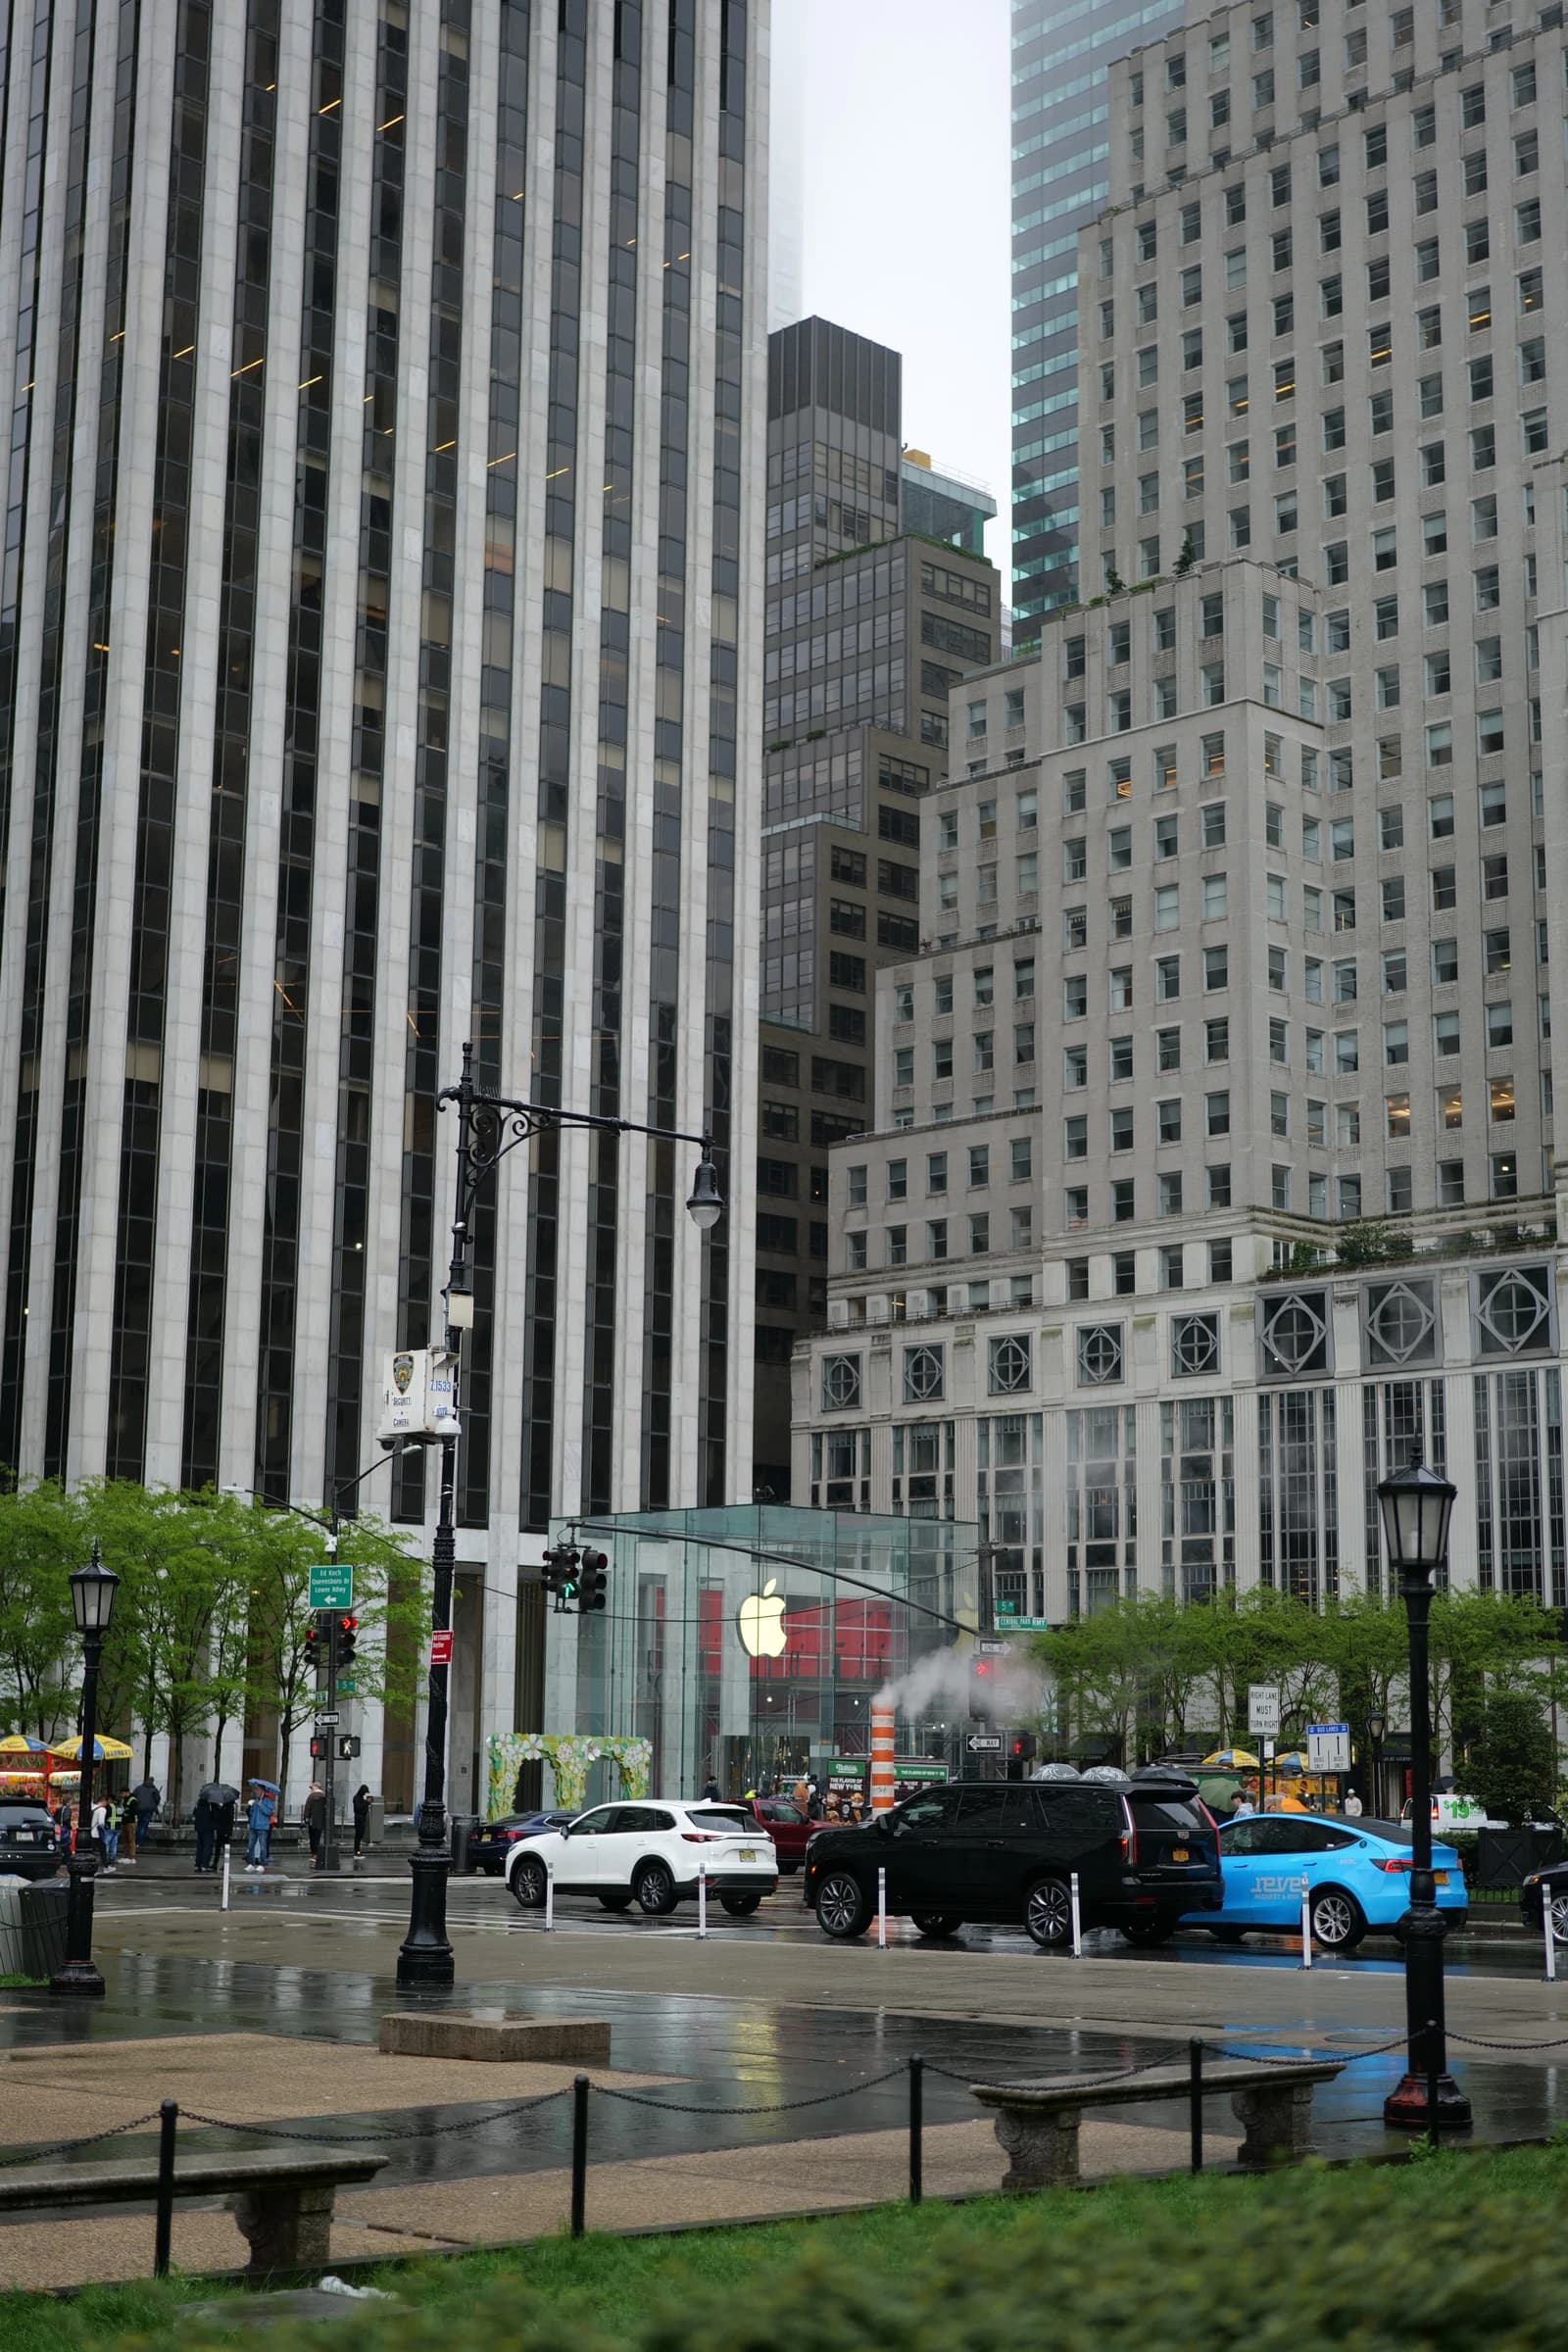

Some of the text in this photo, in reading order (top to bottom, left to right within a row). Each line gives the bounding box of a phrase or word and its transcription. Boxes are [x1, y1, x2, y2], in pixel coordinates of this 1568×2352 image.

[1002, 1600, 1006, 1611] 5
[1000, 1617, 1019, 1626] CENTRAL
[1250, 1691, 1278, 1701] RIGHT LANE
[1255, 1705, 1272, 1715] MUST
[1250, 1720, 1278, 1730] TURN RIGHT
[829, 1783, 863, 1791] NEW YRK
